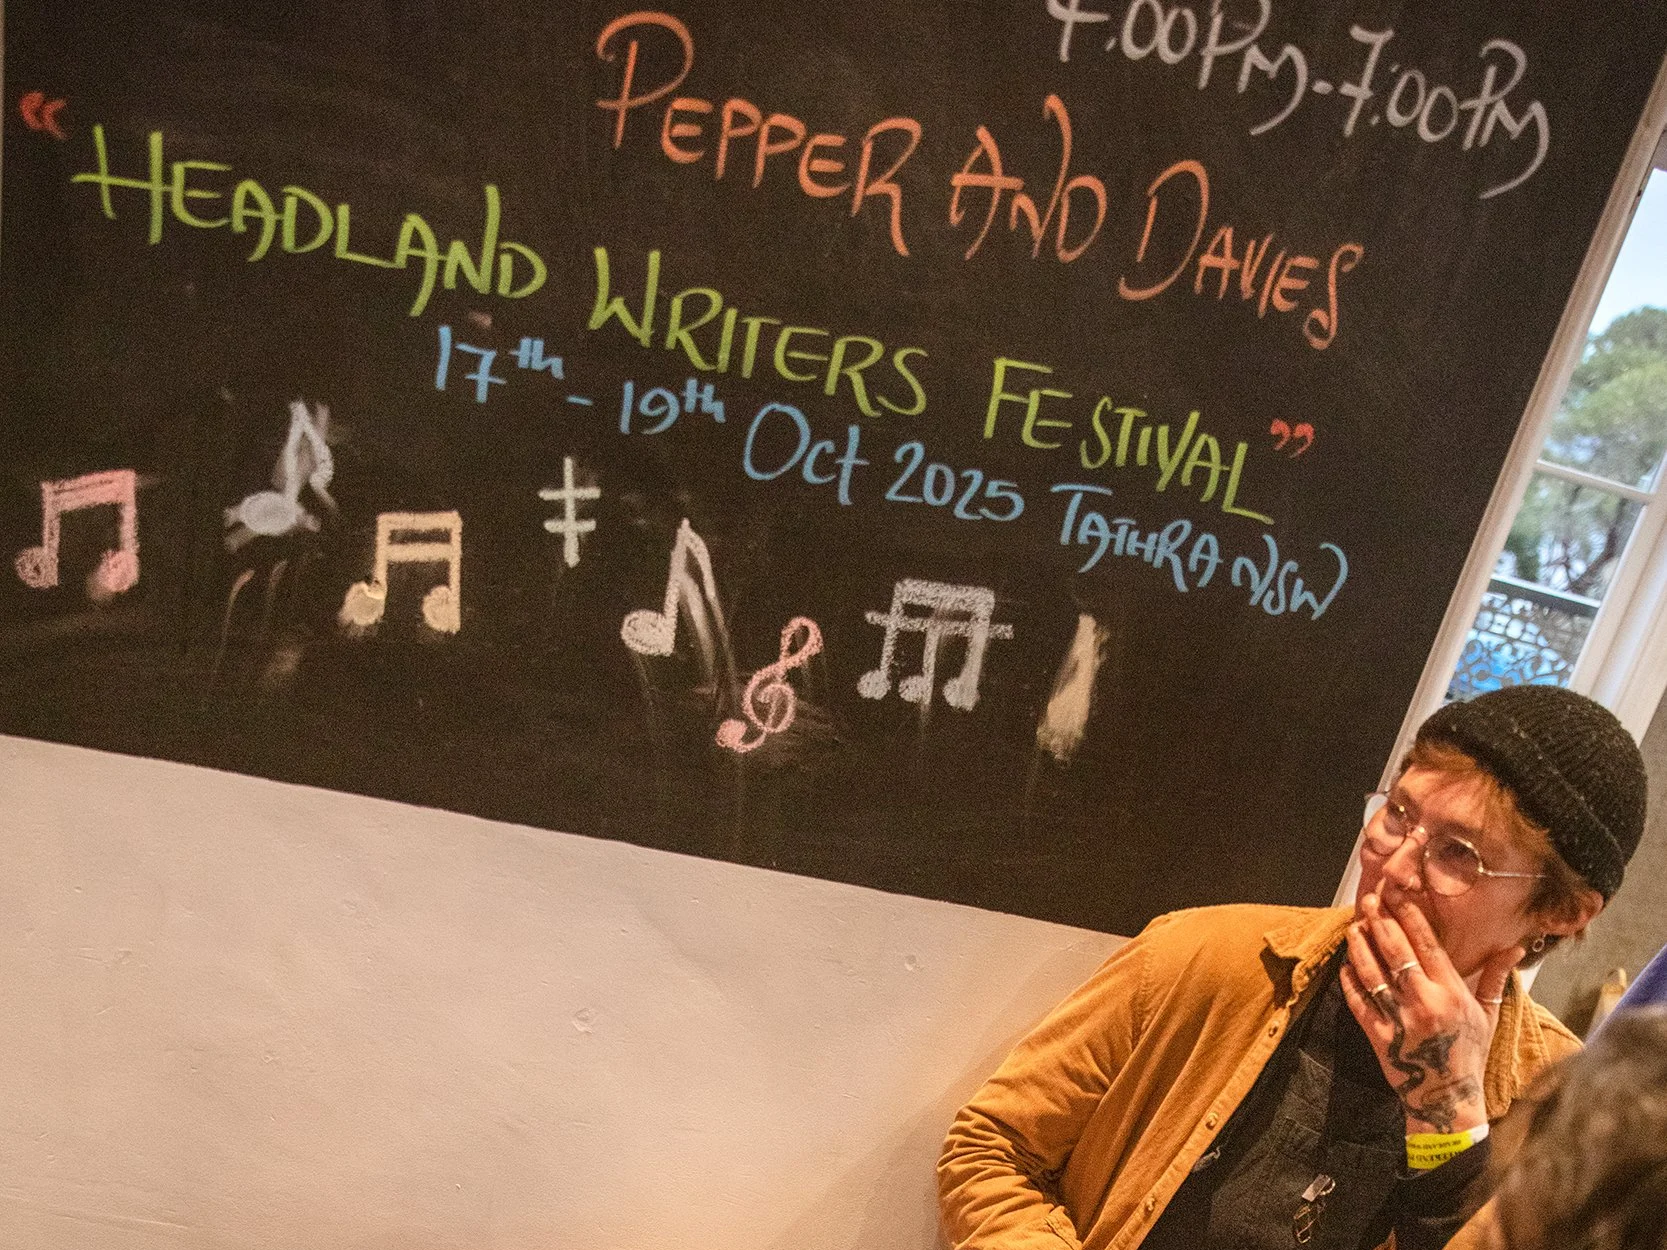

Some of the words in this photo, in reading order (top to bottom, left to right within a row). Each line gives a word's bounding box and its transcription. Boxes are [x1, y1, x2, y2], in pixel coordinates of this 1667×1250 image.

[597, 11, 922, 258] PEPPER
[950, 94, 1107, 264] AND
[1119, 160, 1364, 350] DAVIES
[436, 325, 564, 403] 17th
[619, 378, 726, 435] 19th
[743, 403, 870, 506] Oct
[886, 442, 1025, 520] 2025
[1050, 485, 1224, 593] TATHRA
[1231, 535, 1349, 620] NSW
[588, 246, 928, 417] WRITERS
